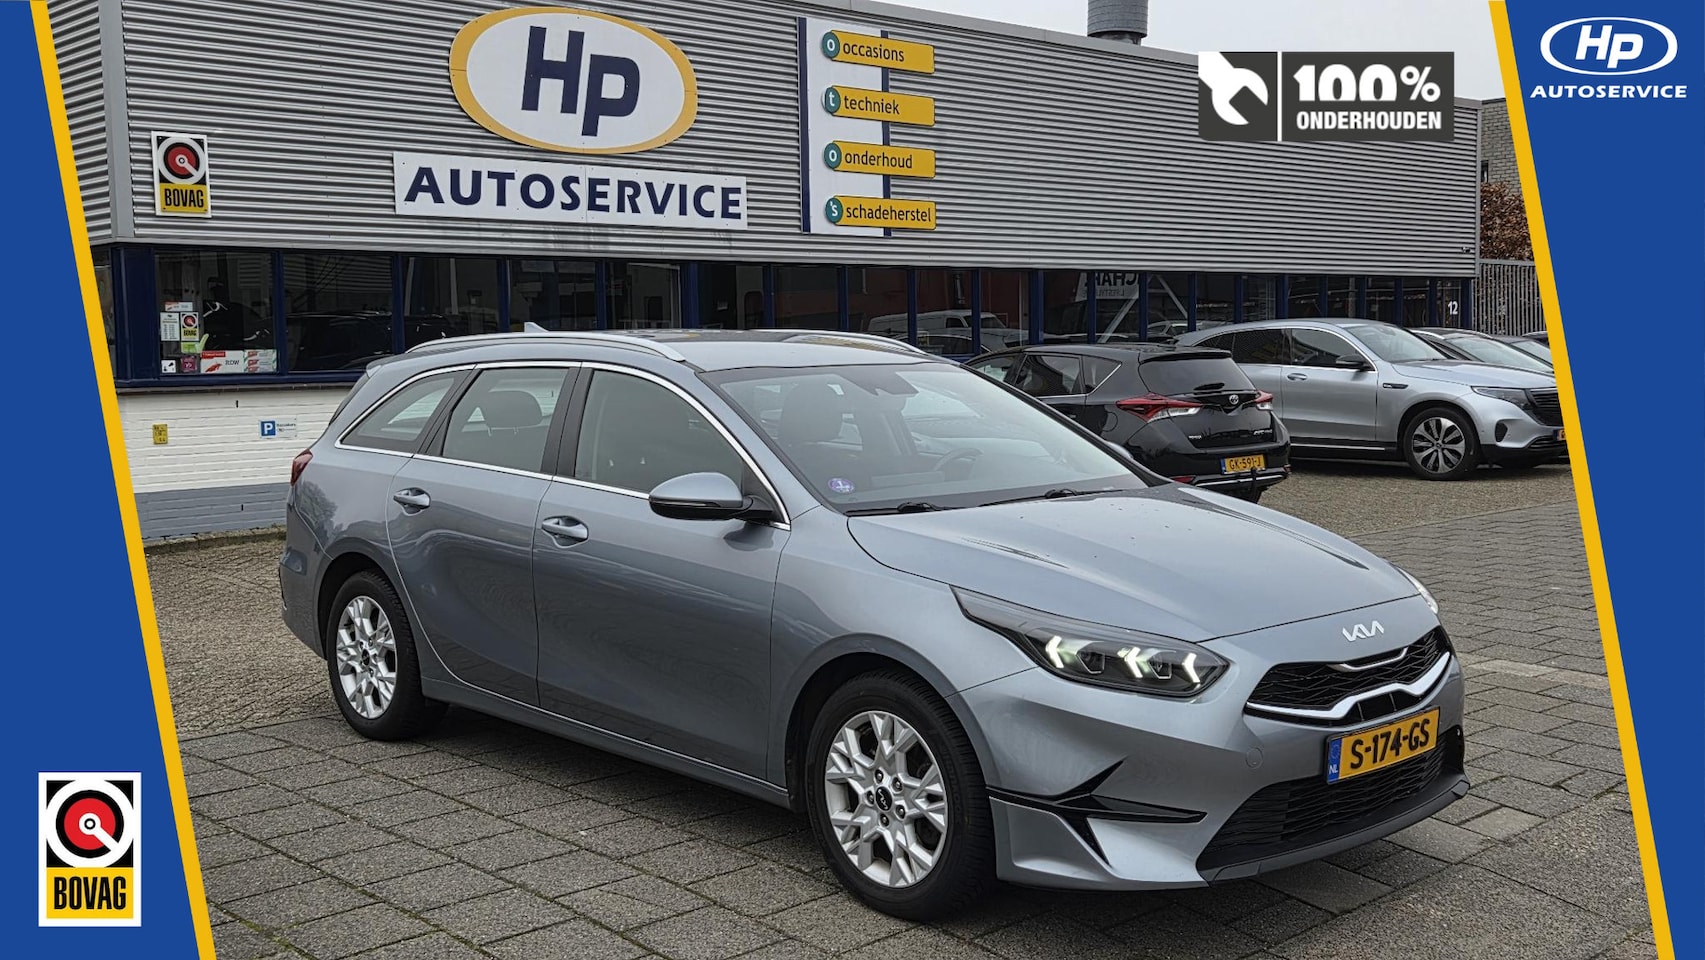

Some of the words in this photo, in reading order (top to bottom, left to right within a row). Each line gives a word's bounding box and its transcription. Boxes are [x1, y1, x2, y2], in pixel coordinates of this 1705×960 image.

[843, 42, 905, 62] occasions
[844, 95, 900, 115] techniek
[844, 150, 913, 169] onderhoud
[164, 188, 204, 208] BOVAG
[404, 166, 742, 220] AUTOSERVICE
[846, 204, 931, 222] schadeherstel
[1447, 300, 1459, 315] 12
[1350, 718, 1431, 770] S-174-GS
[1328, 764, 1339, 775] NL
